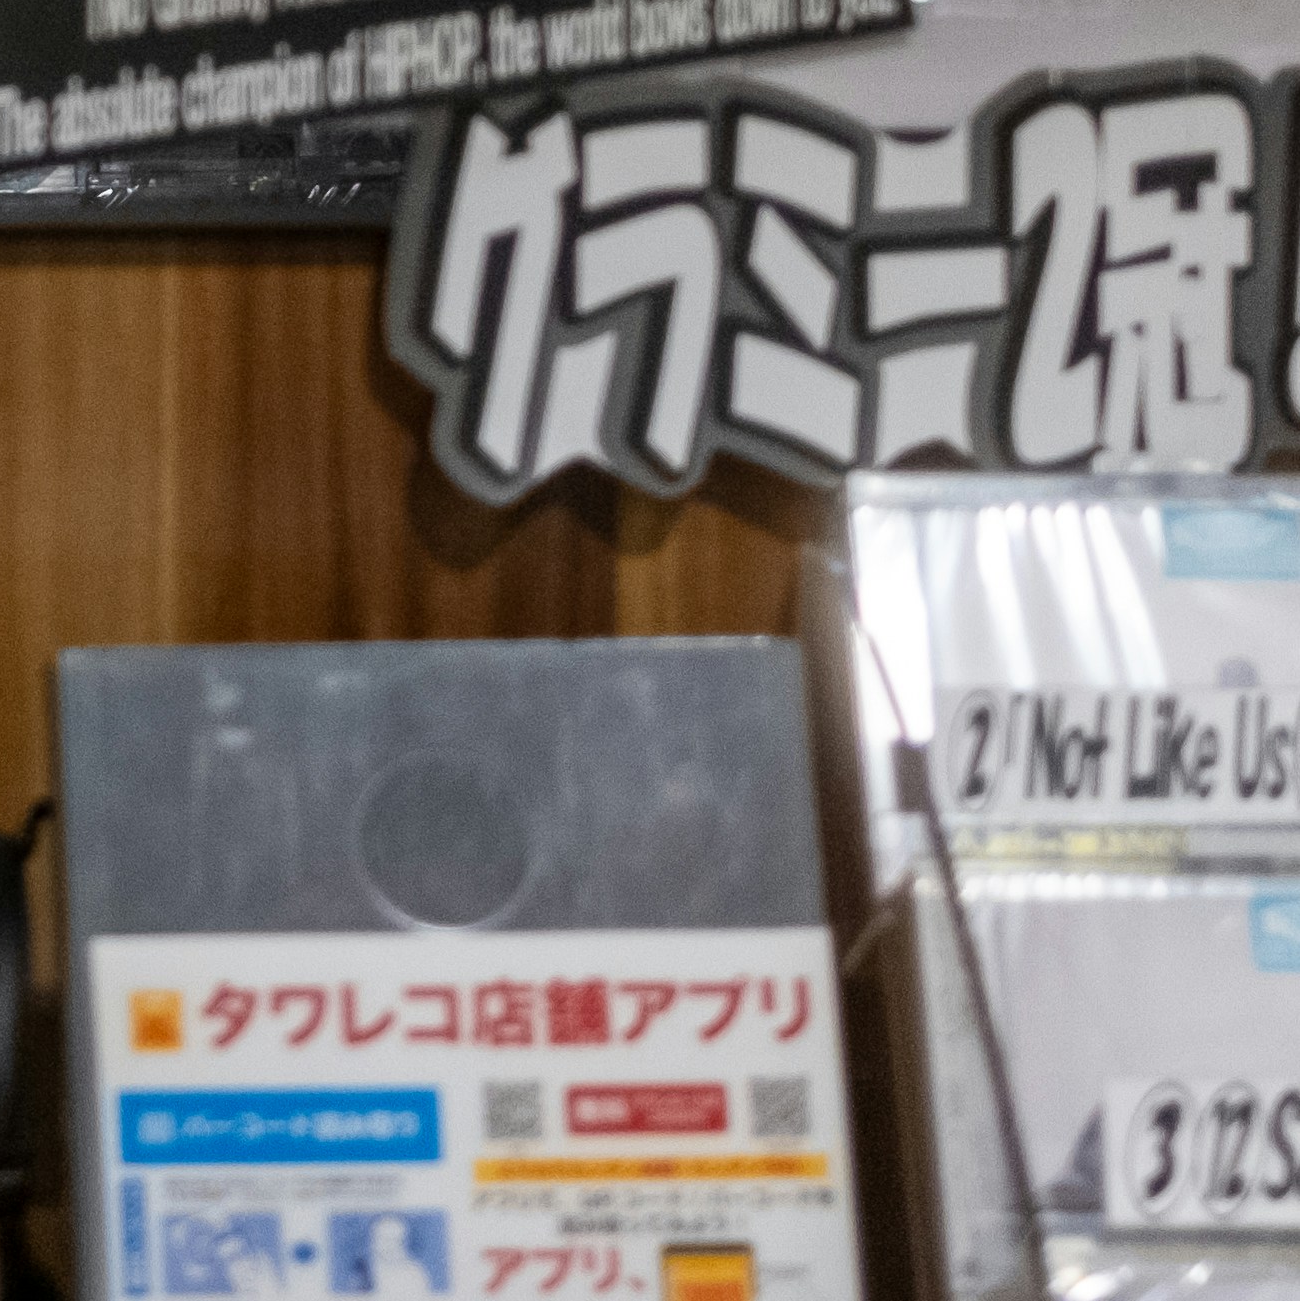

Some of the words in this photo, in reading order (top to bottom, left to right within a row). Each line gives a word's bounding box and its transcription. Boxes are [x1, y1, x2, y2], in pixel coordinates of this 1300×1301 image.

[1127, 692, 1219, 799] Like
[203, 977, 812, 1050] タワレコ店舗アプリ
